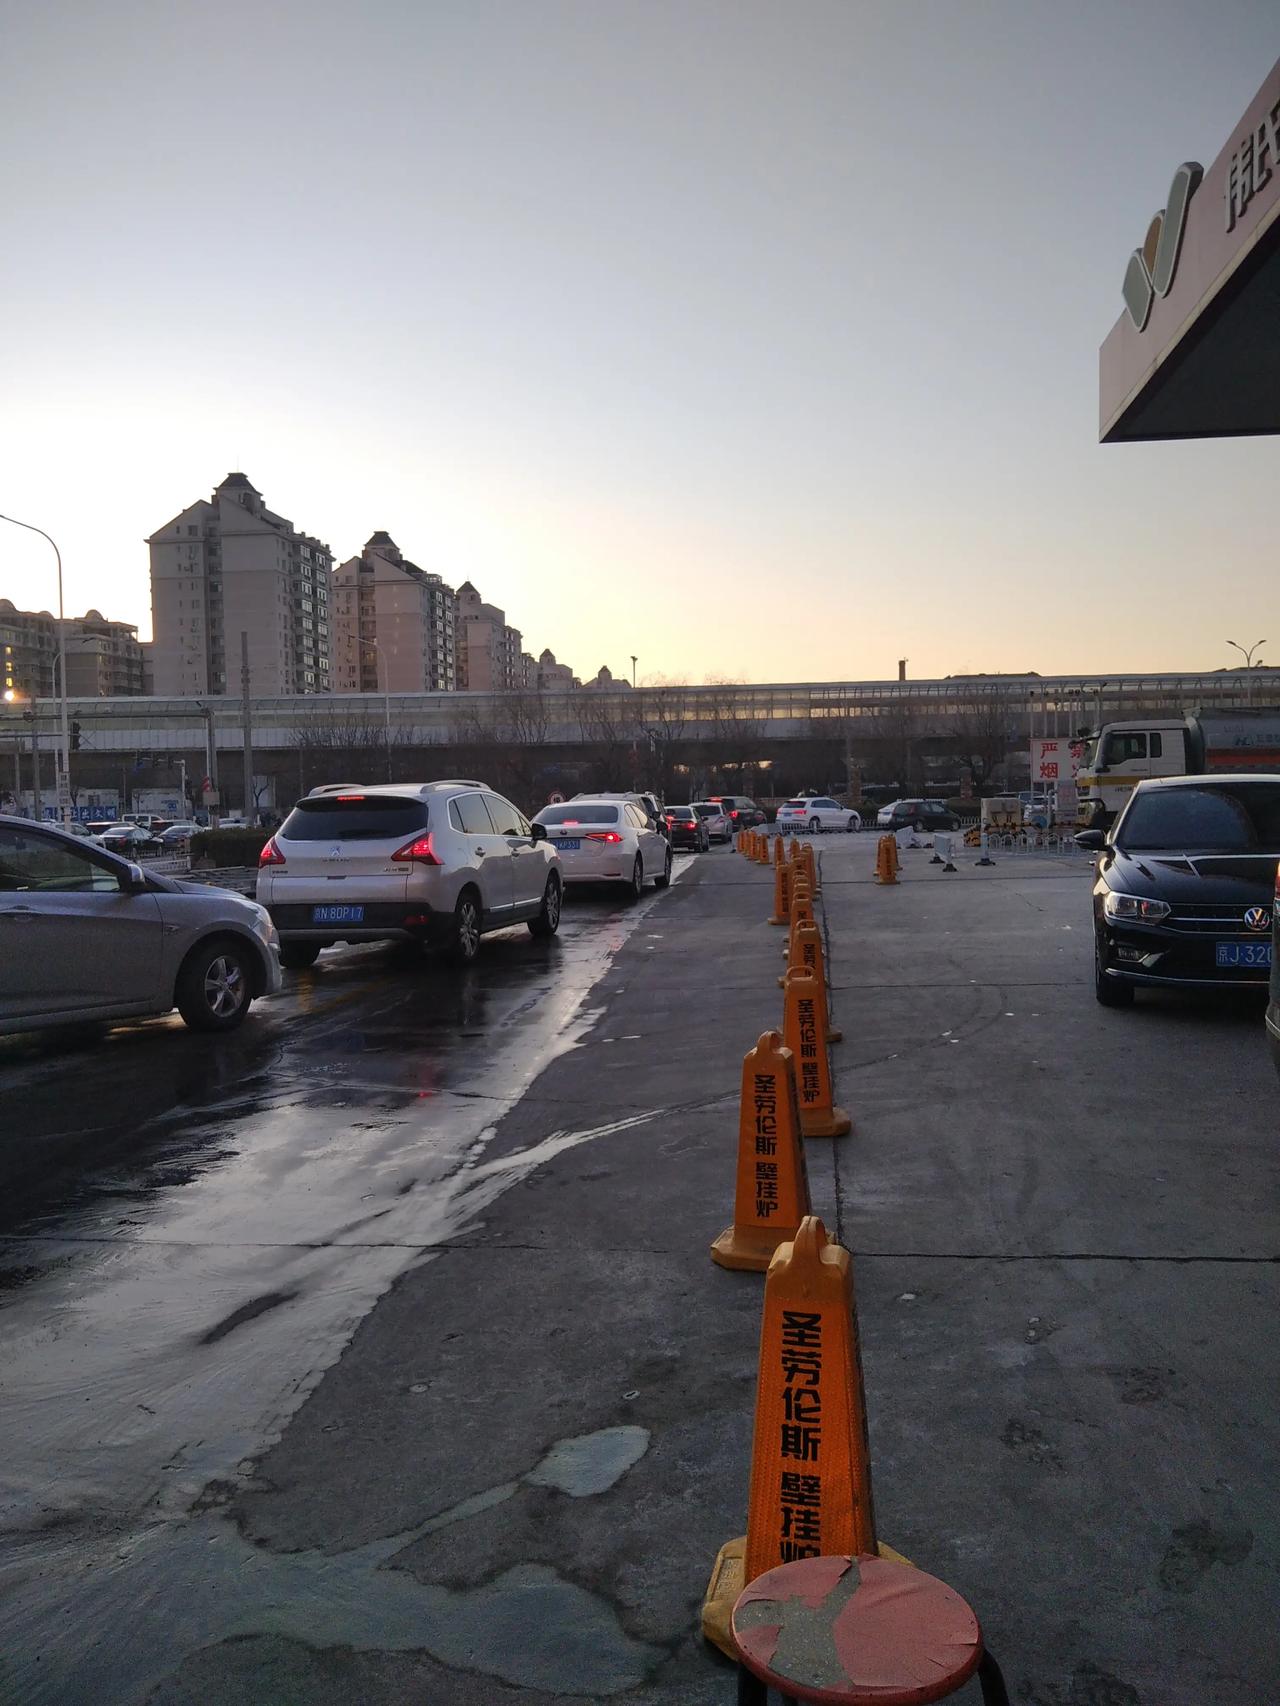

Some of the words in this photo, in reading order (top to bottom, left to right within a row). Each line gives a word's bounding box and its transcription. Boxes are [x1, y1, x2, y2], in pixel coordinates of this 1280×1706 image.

[798, 999, 816, 1058] 圣劳伦斯
[801, 1062, 820, 1104] 壁挂炉
[755, 1074, 777, 1156] 圣劳伦斯
[756, 1162, 778, 1218] 壁挂炉
[781, 1310, 822, 1461] 圣劳伦斯
